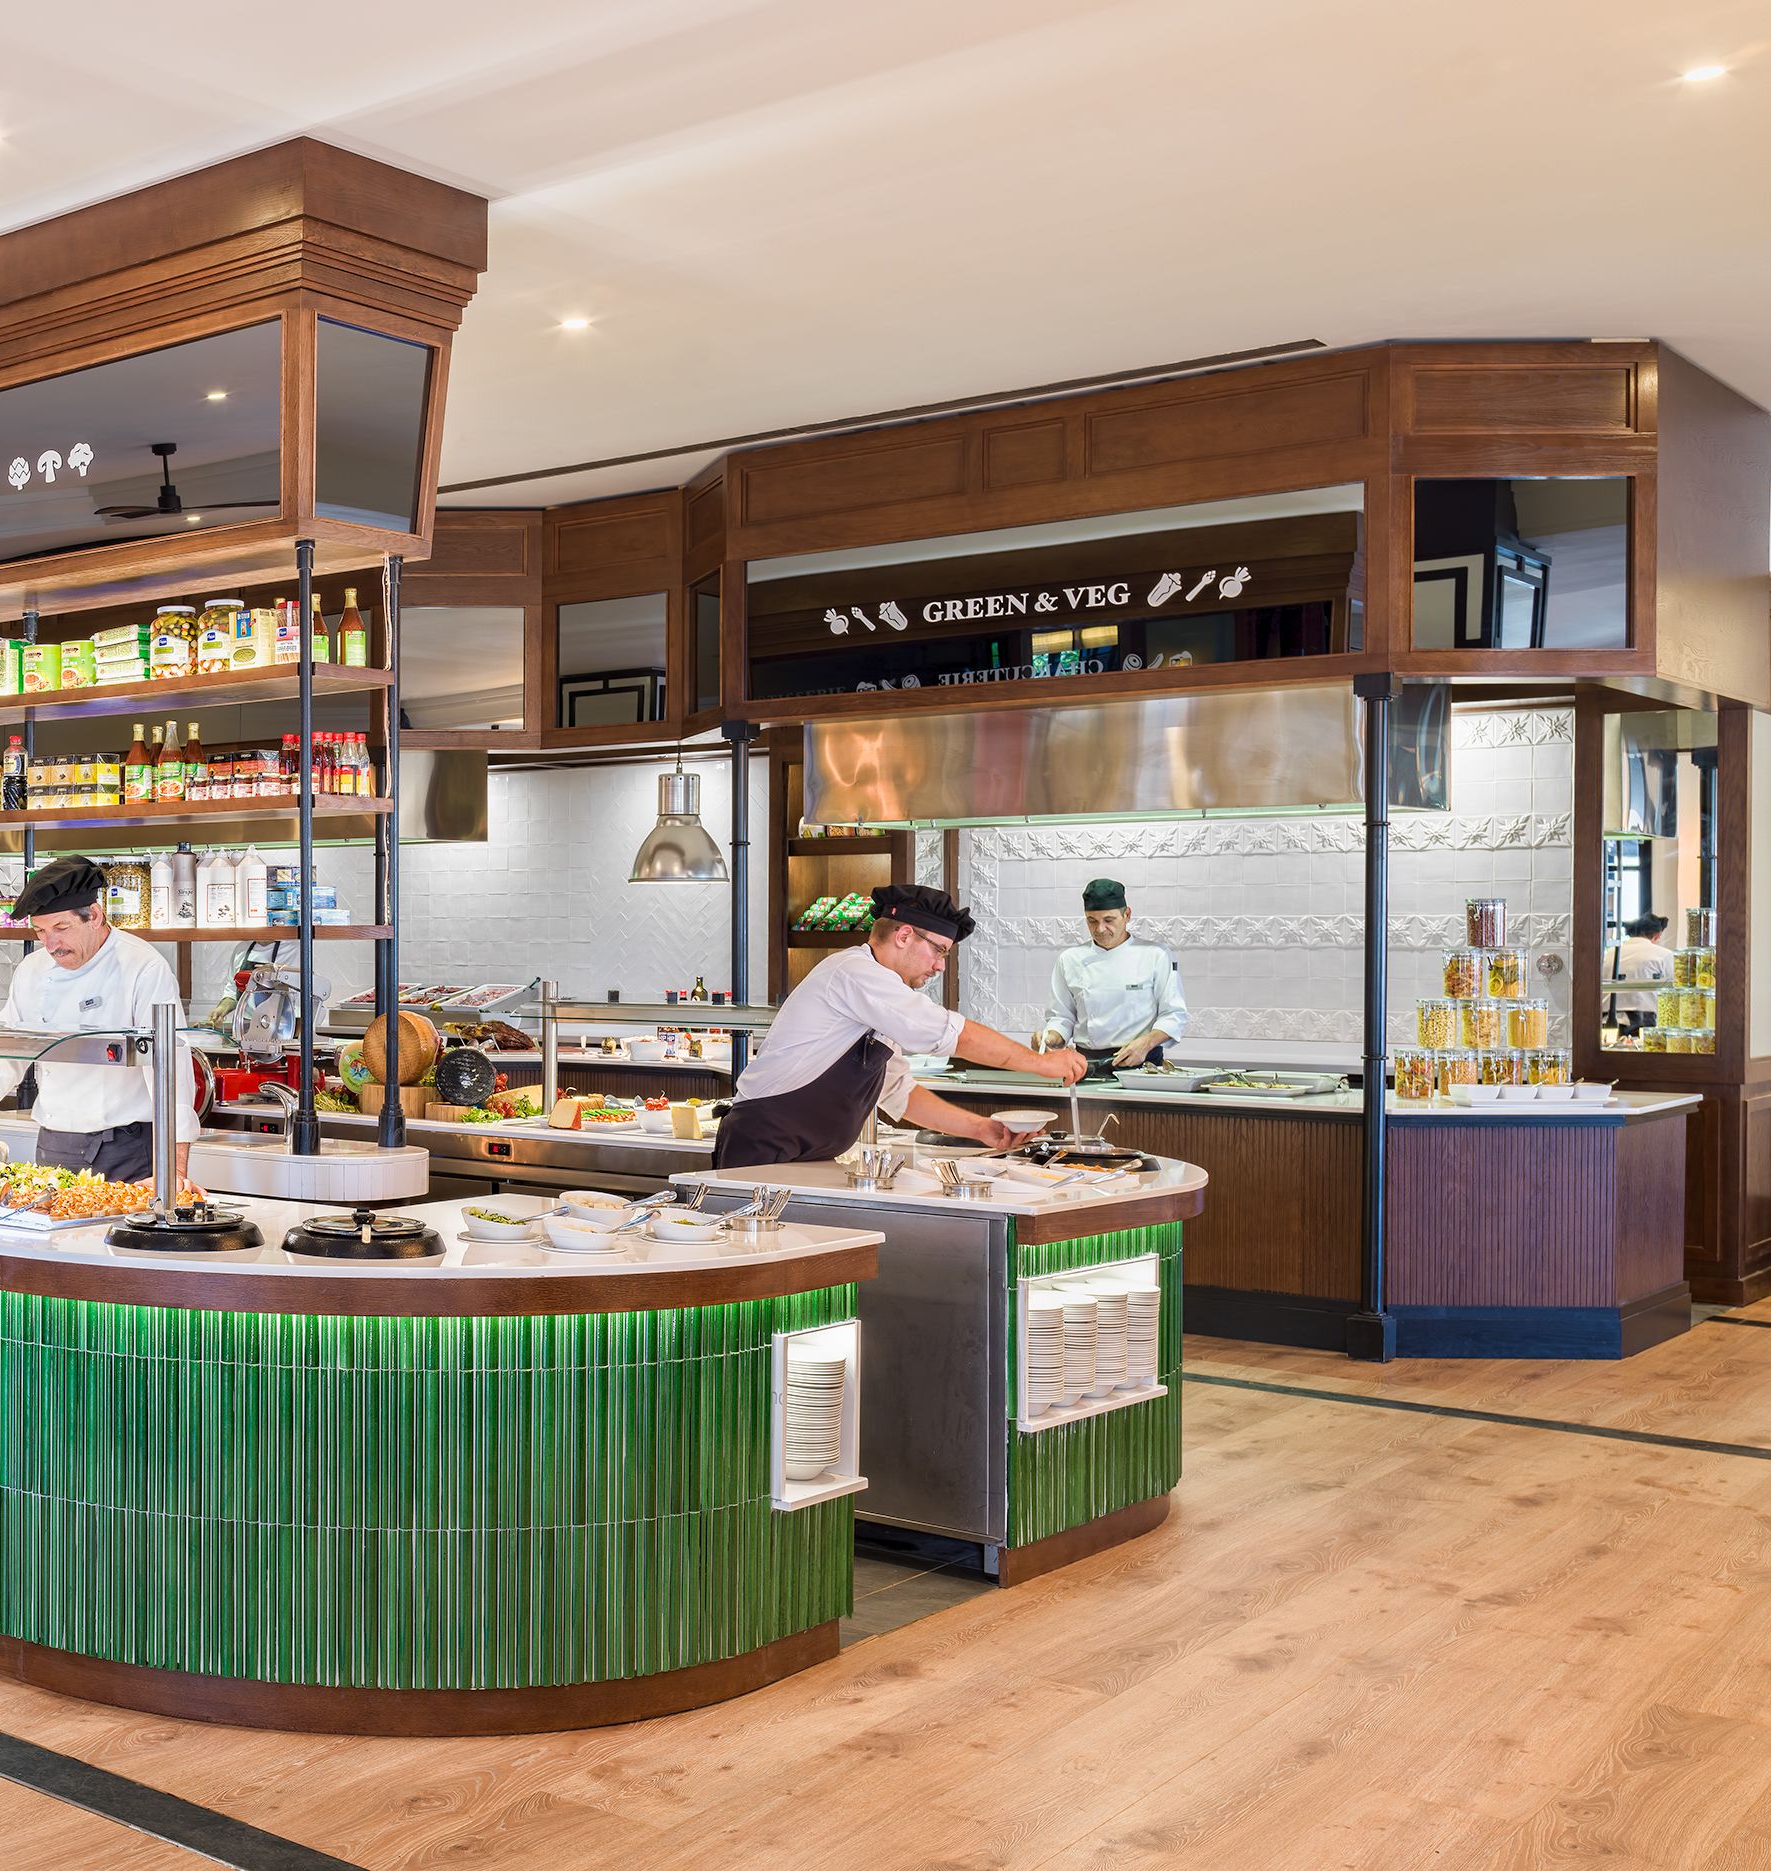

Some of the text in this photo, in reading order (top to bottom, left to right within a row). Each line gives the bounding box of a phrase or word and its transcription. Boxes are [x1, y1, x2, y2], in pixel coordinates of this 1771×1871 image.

[922, 581, 1132, 623] GREEN & VEG
